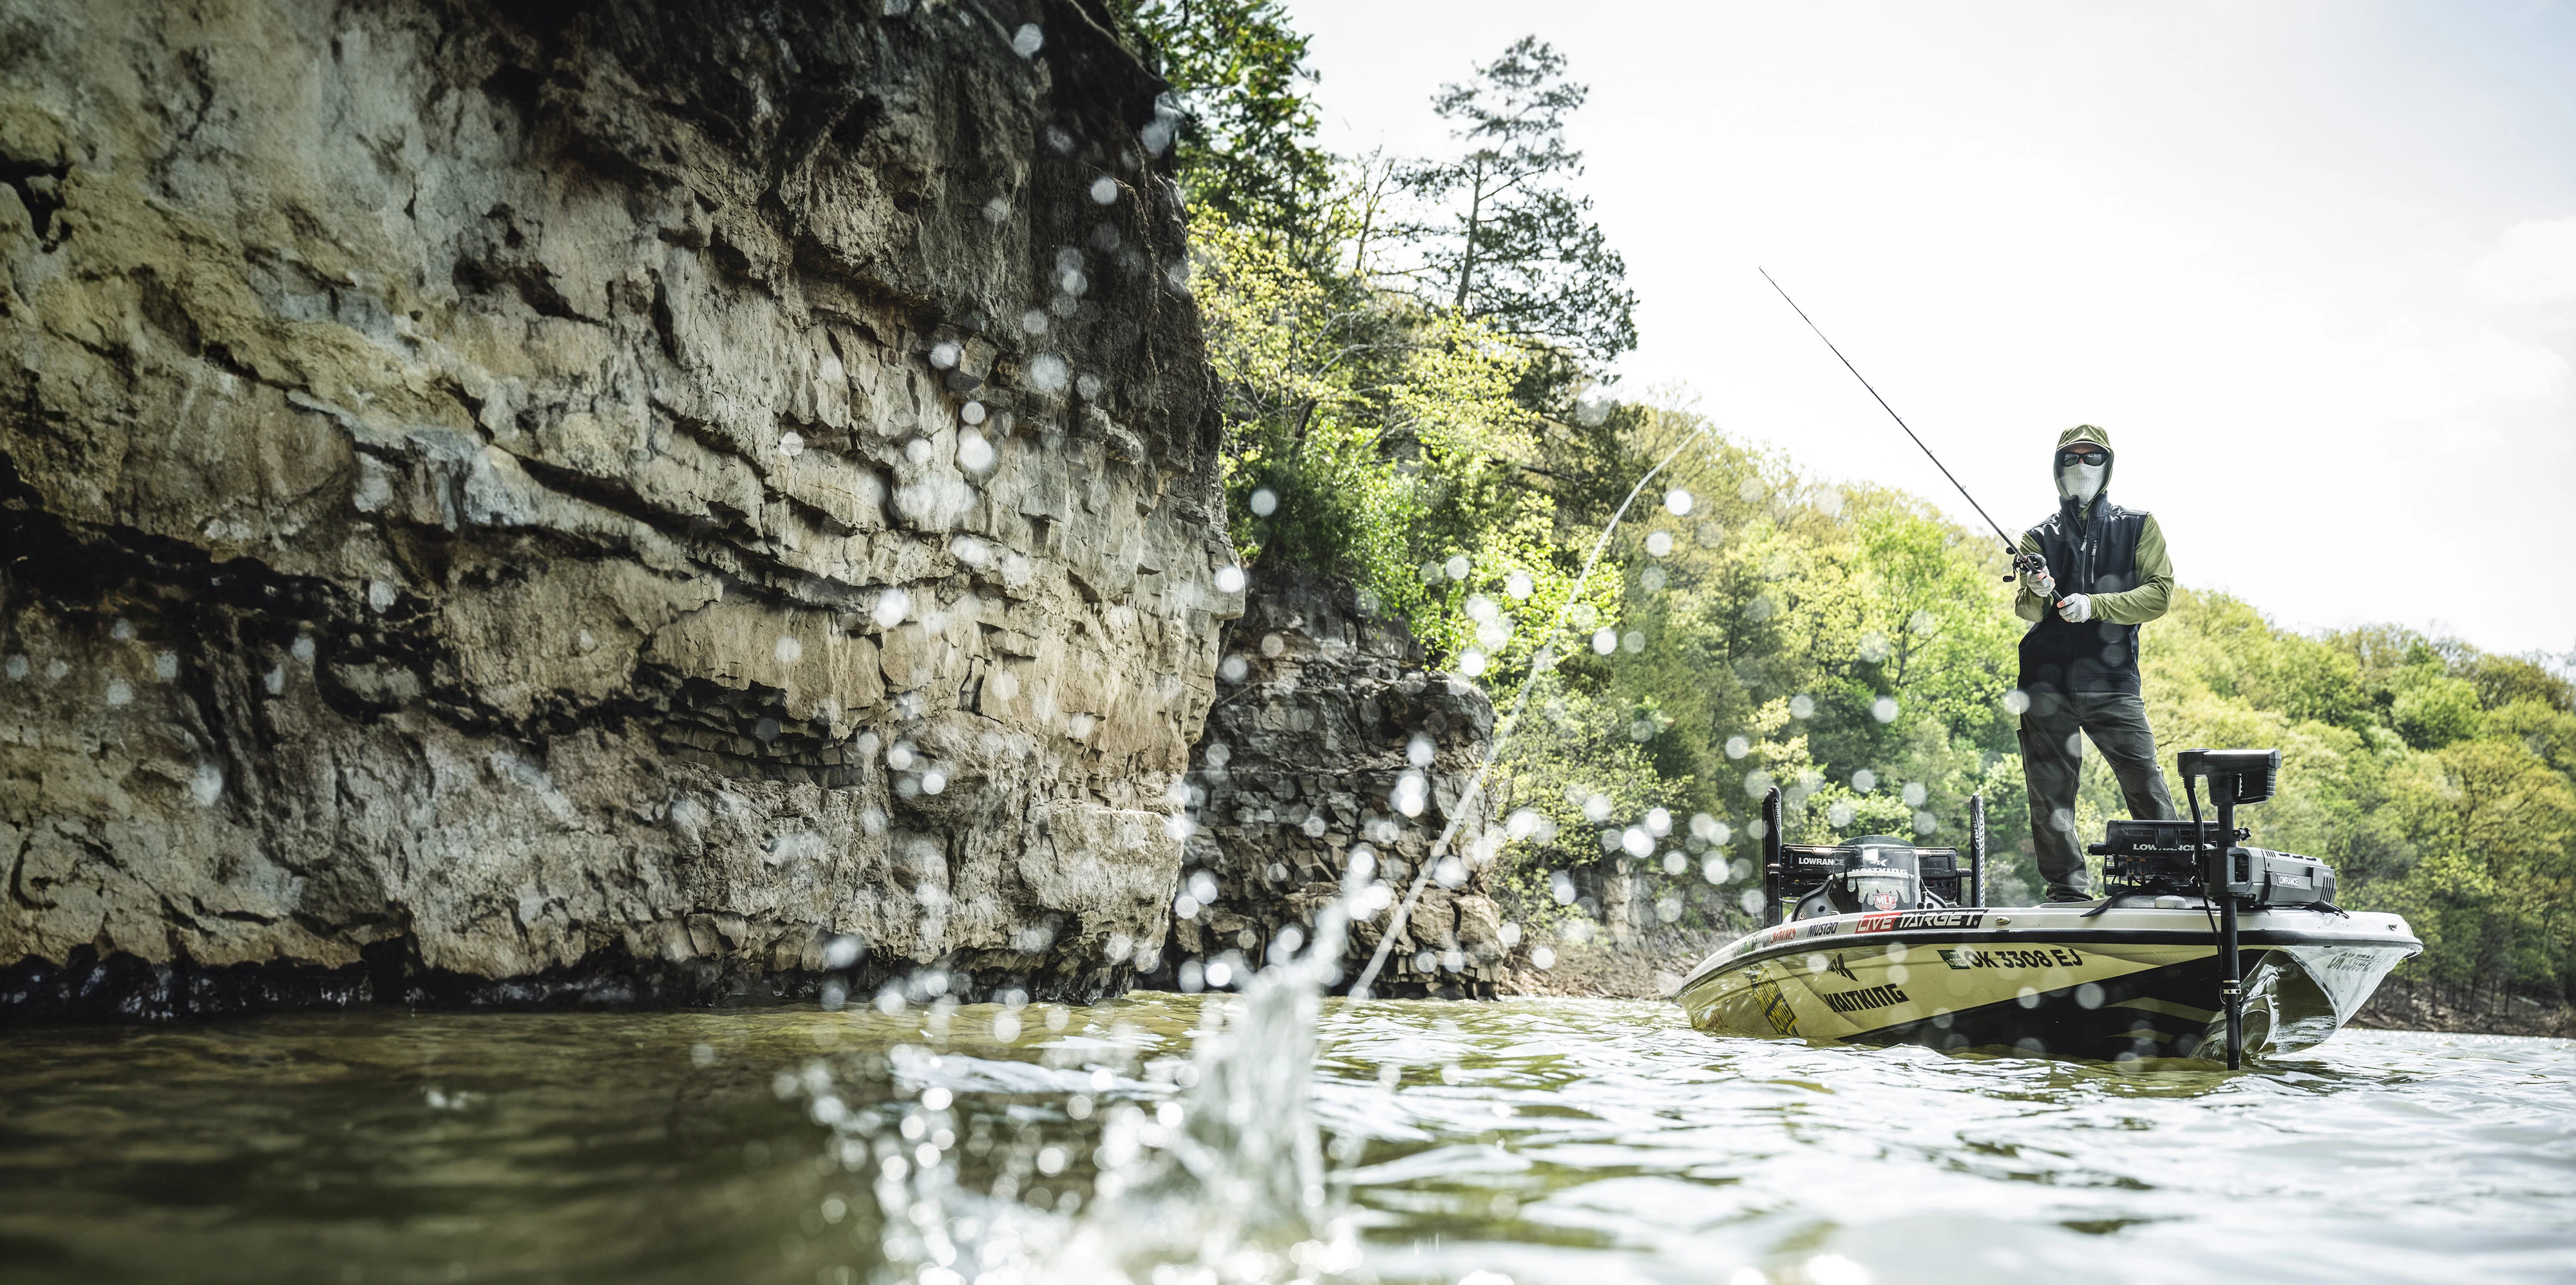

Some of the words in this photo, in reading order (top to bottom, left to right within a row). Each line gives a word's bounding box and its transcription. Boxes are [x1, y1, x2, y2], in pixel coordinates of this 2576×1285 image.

[1799, 858, 1844, 866] LOWRANCE
[2278, 876, 2298, 886] LOWRANCE
[1875, 896, 1895, 905] MLF
[1857, 915, 1893, 932] LIVE
[1899, 912, 1984, 928] TARGET
[1770, 927, 1797, 944] SIMMS
[1964, 950, 2000, 968] OK
[1994, 950, 2053, 968] 3308
[2049, 948, 2083, 967] EJ
[1823, 983, 1909, 1013] KASTKING
